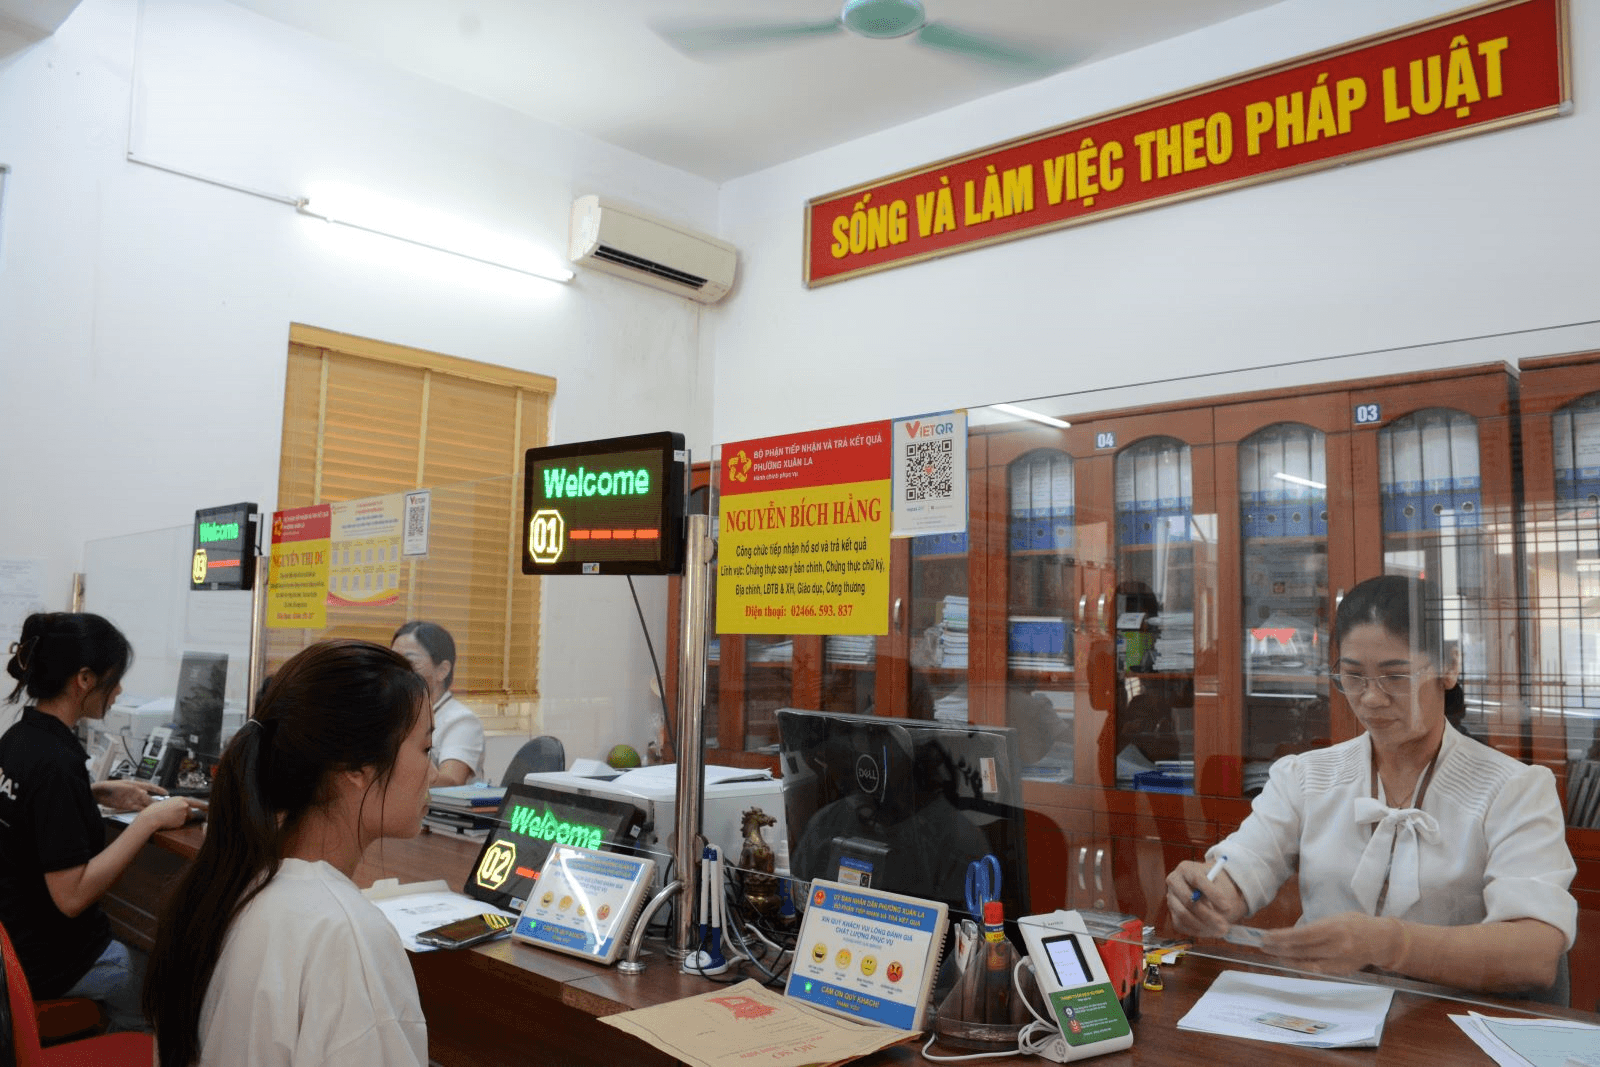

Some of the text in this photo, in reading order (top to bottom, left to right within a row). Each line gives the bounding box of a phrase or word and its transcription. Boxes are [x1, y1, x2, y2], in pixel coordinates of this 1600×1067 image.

[830, 34, 1511, 260] SỐNG VÀ LÀM VIỆC THEO PHÁP LUẬT
[1357, 404, 1378, 422] 03
[905, 420, 954, 439] VIETQR
[1097, 432, 1114, 448] 04
[765, 447, 784, 458] PHẬN
[785, 443, 800, 455] TIẾP
[801, 442, 822, 453] NHẬN
[823, 441, 833, 451] VÀ
[850, 434, 865, 446] KẾT
[866, 433, 882, 446] QUẢ
[753, 461, 782, 472] PHƯỜNG
[803, 457, 813, 466] LA
[543, 467, 649, 499] Welcome
[726, 500, 786, 533] NGUYỄN
[790, 497, 829, 528] BÍCH
[533, 517, 559, 554] 01
[736, 545, 752, 559] Công
[770, 541, 781, 557] tiếp
[783, 542, 799, 556] nhận
[821, 540, 828, 552] và
[831, 538, 839, 552] trả
[842, 537, 852, 551] kết
[854, 536, 867, 553] quả
[826, 560, 845, 575] Chứng
[848, 560, 860, 574] thực
[826, 581, 842, 596] Công
[745, 605, 762, 620] Điện
[837, 604, 854, 617] 837
[511, 805, 602, 850] Welcome
[482, 847, 511, 883] 02
